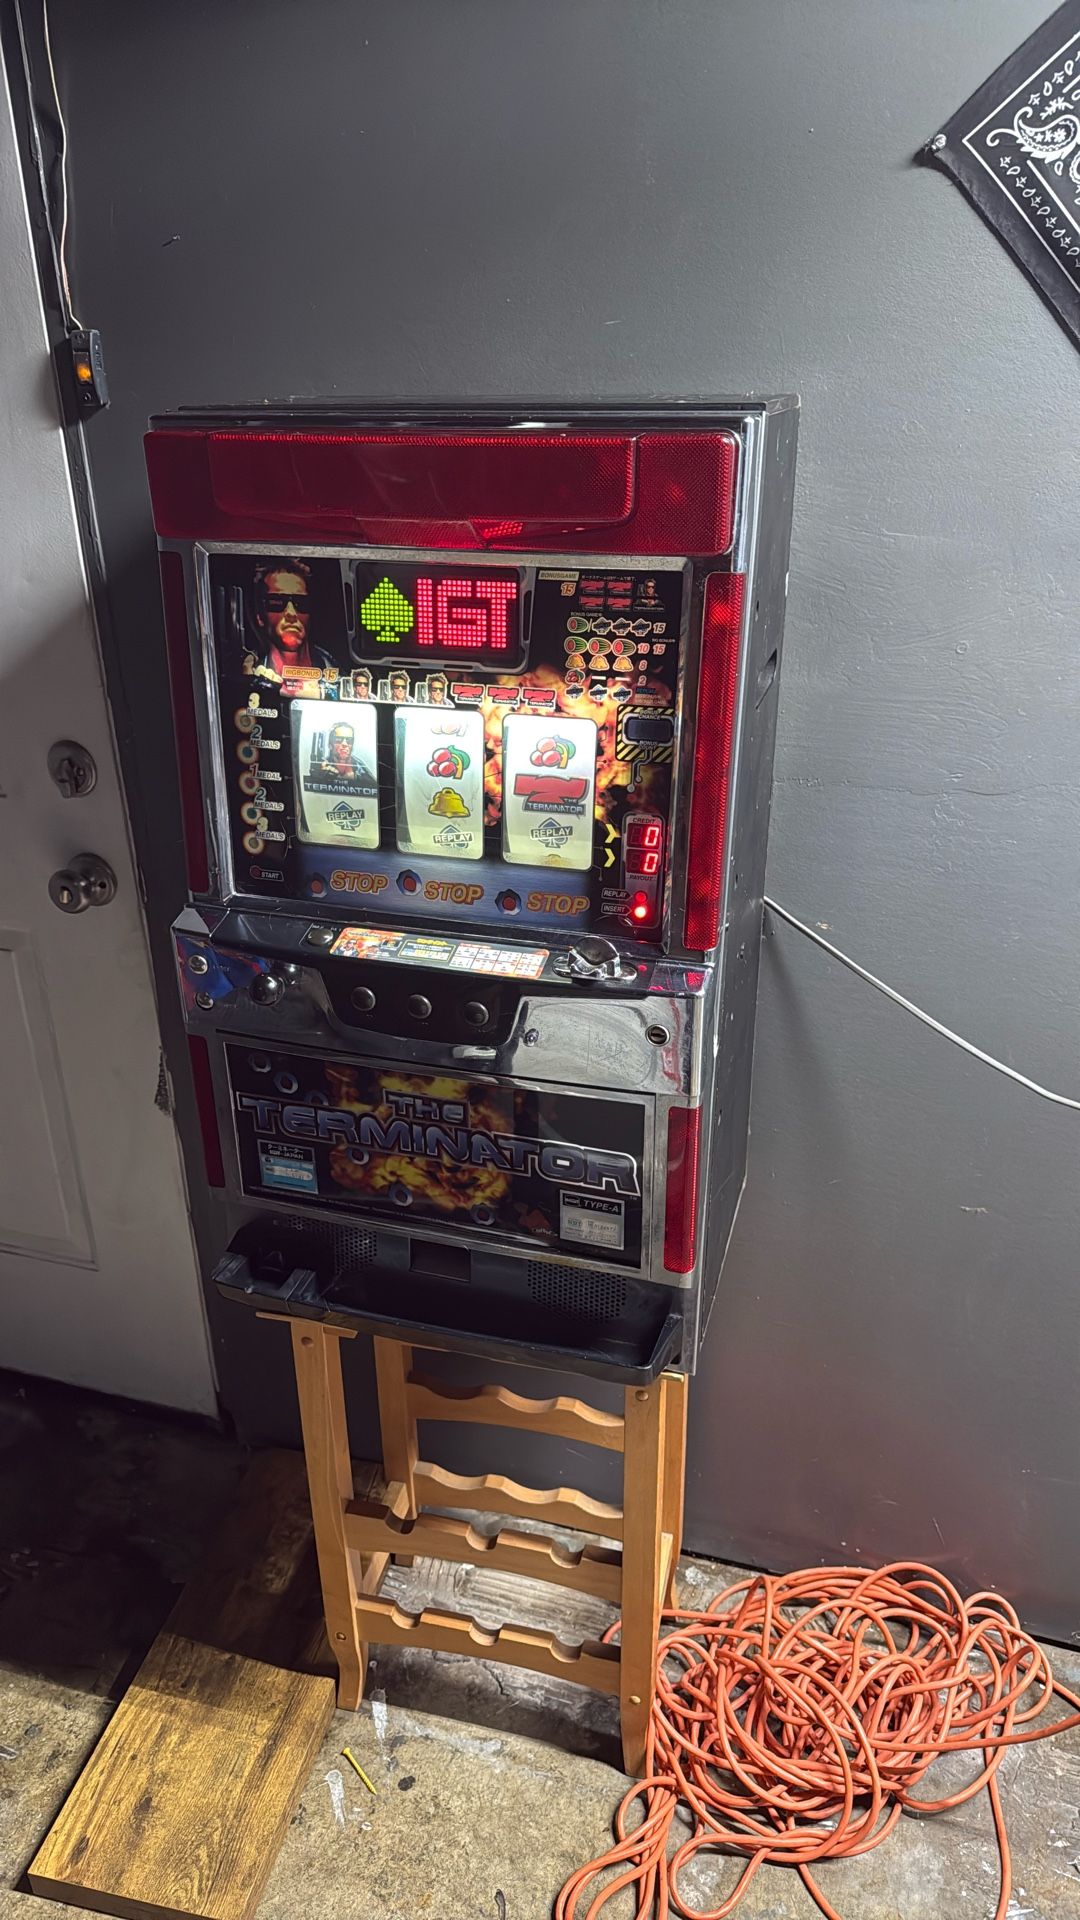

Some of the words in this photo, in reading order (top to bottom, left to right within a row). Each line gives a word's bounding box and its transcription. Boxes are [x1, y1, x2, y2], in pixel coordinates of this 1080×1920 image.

[561, 582, 576, 596] 15
[417, 578, 517, 648] IGT
[653, 622, 666, 634] 15
[638, 643, 650, 654] 10
[653, 644, 666, 655] 15
[639, 660, 647, 670] 8
[324, 668, 339, 682] 15
[638, 676, 647, 686] 2
[248, 692, 260, 708] 3
[247, 708, 277, 717] MEDALS
[250, 724, 262, 740] 2
[250, 740, 279, 749] MEDALS
[250, 763, 259, 778] 1
[256, 772, 280, 780] MEDAL
[256, 787, 266, 801] 2
[304, 782, 378, 795] TERMINATOR
[254, 801, 284, 810] MEDALS
[528, 802, 583, 813] TERMINATOR
[328, 810, 362, 820] REPLAY
[256, 816, 268, 832] 3
[256, 831, 284, 840] MEDALS
[435, 833, 472, 843] REPLAY
[532, 826, 572, 838] REPLAY
[644, 826, 660, 846] 0
[644, 853, 658, 872] 0
[331, 870, 388, 894] STOP
[424, 881, 484, 905] STOP
[603, 890, 627, 898] REPLAY
[526, 892, 590, 917] STOP
[387, 1094, 464, 1122] THE
[240, 1095, 638, 1194] TERMINATOR
[584, 1200, 619, 1213] TYPE-A
